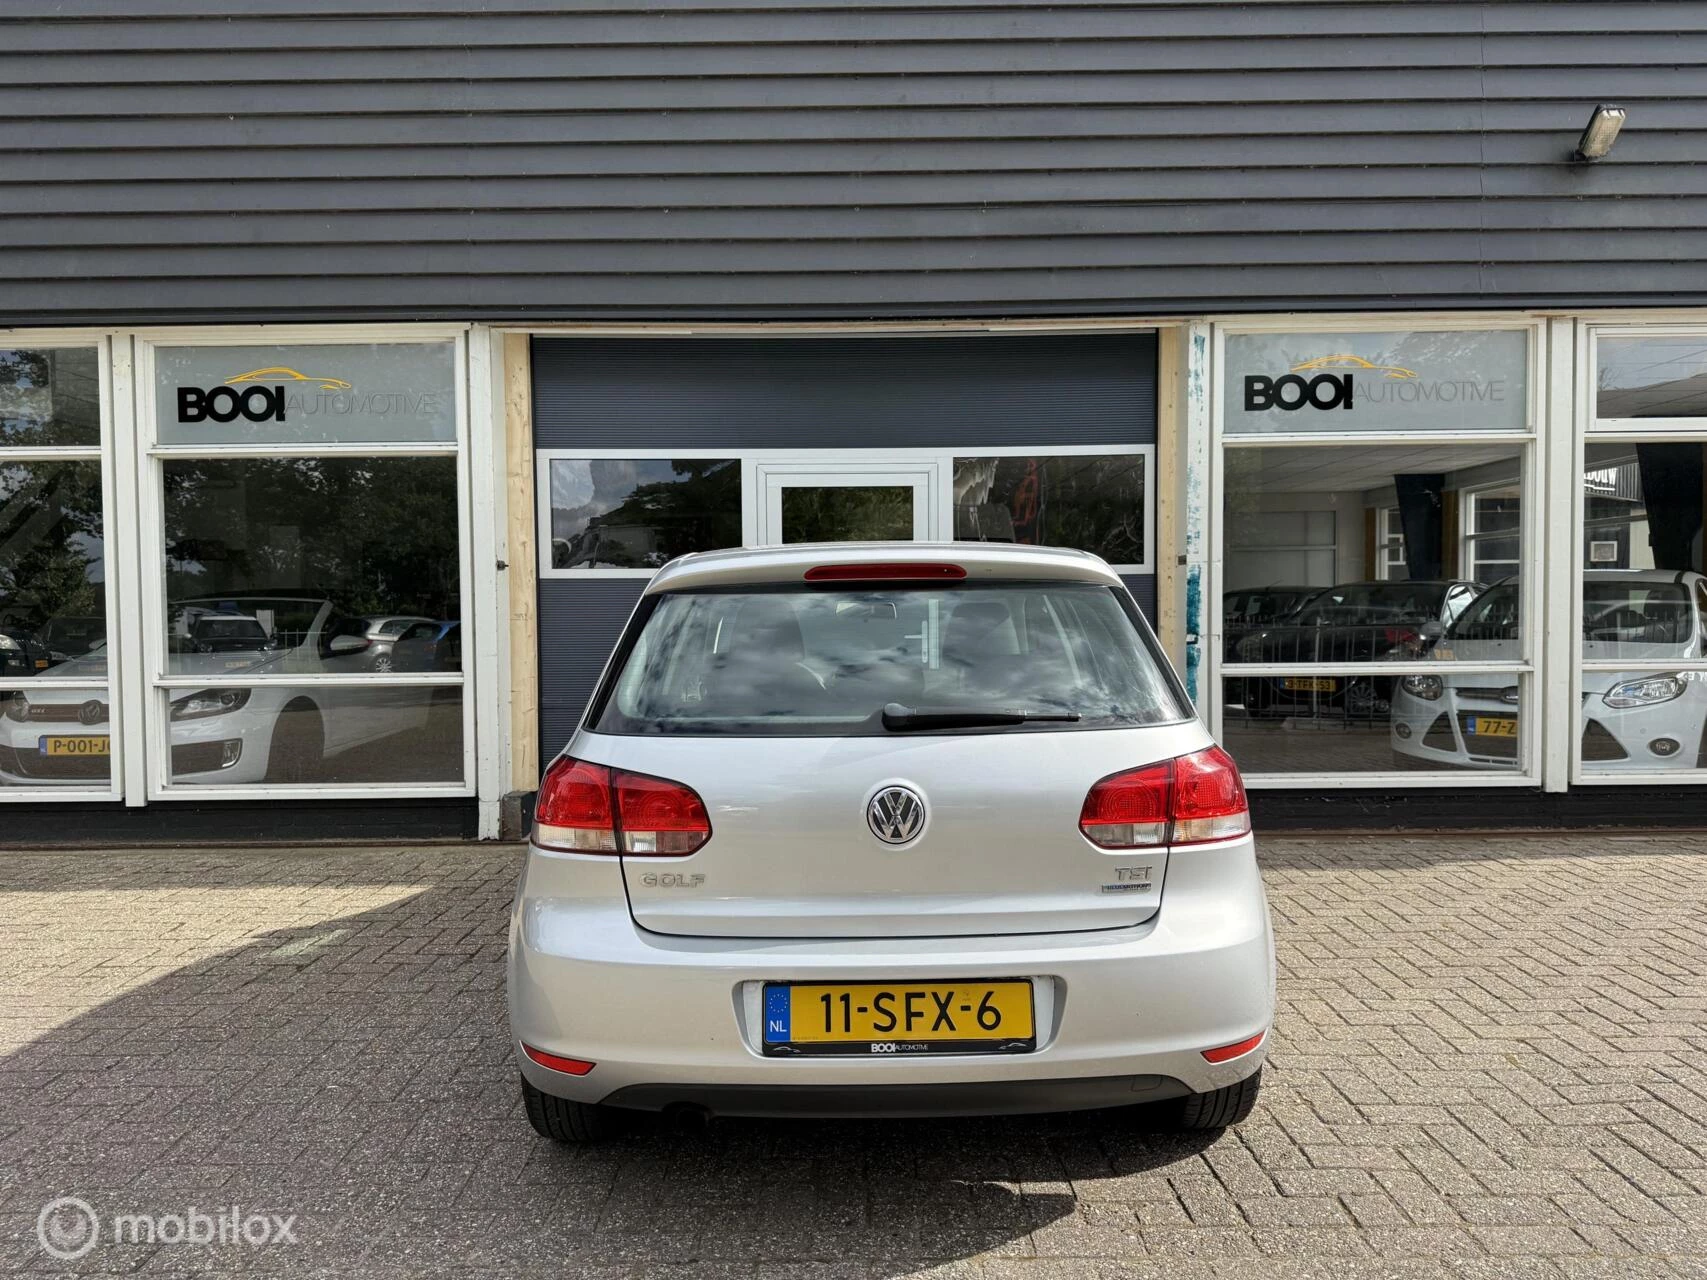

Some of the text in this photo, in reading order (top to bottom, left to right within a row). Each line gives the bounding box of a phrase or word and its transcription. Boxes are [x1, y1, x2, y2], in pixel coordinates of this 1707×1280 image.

[1244, 374, 1505, 411] BOOI AUTOMOTIVE
[177, 386, 435, 423] BOOI AUTOMOTIVE
[54, 740, 110, 753] P-001-J
[640, 872, 705, 888] GOLF
[1115, 866, 1152, 881] TSI
[820, 991, 1002, 1033] 11-SFX-6
[769, 1020, 787, 1033] NL
[871, 1043, 896, 1053] BOOI
